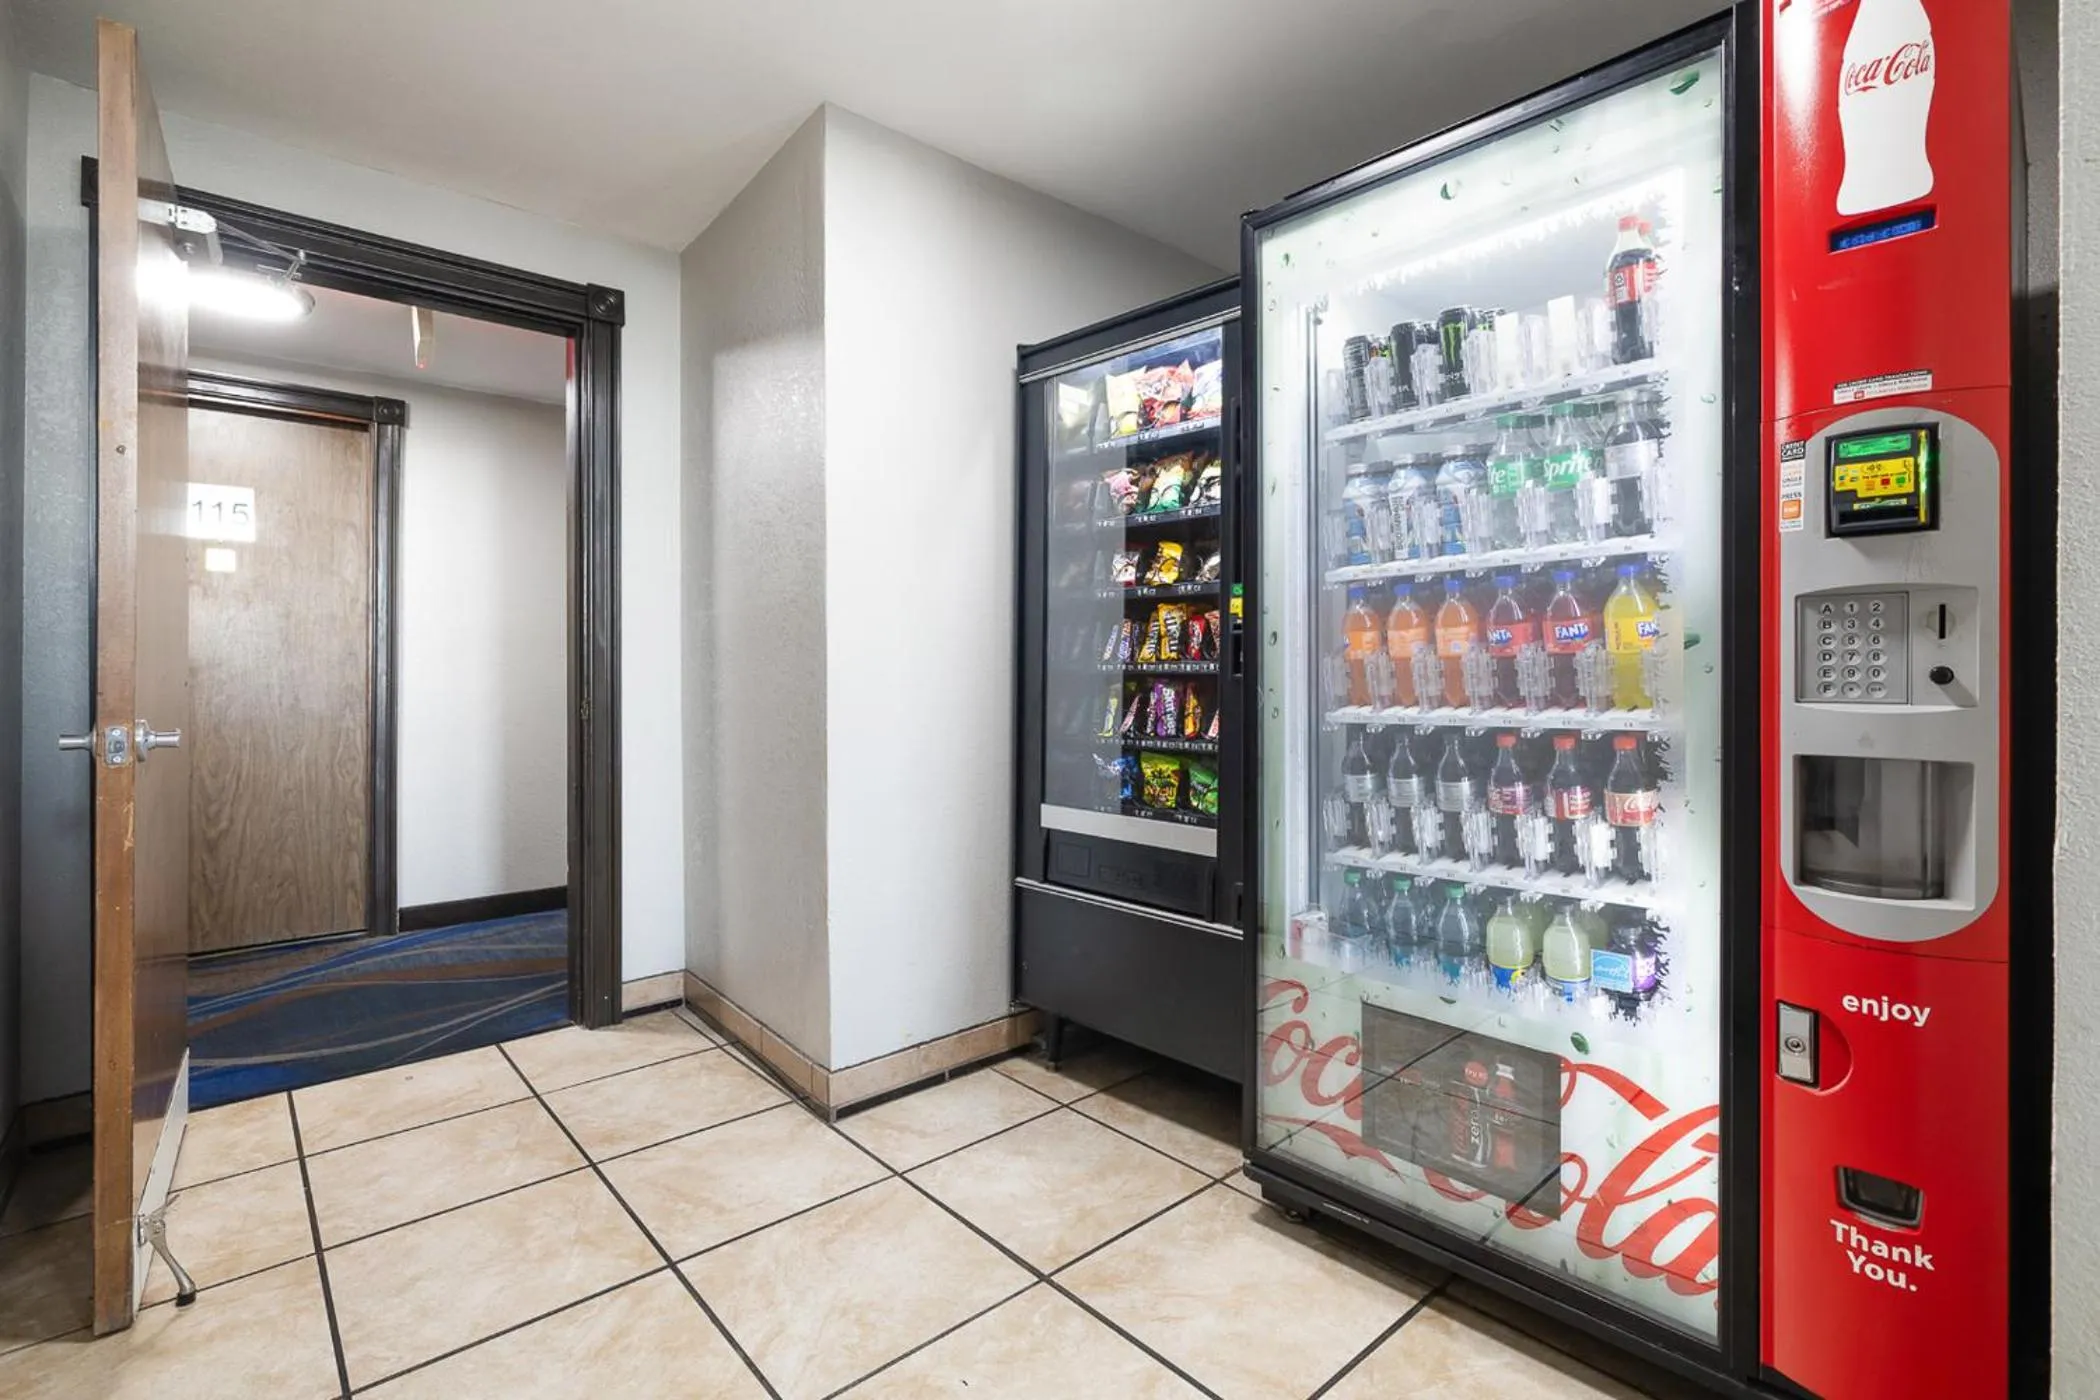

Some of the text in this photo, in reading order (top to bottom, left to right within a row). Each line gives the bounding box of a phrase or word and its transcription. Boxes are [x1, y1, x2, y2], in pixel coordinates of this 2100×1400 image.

[1845, 39, 1931, 96] Coca-Cola
[1782, 447, 1804, 457] CARD
[1544, 453, 1592, 480] Sprite
[192, 500, 248, 526] 115
[1822, 603, 1881, 614] A 1 2
[1555, 622, 1588, 641] FANTA
[1822, 619, 1880, 629] B 3 4
[1822, 636, 1881, 646] C 5 6
[1822, 652, 1880, 662] D 7 8
[1822, 669, 1881, 678] E 9 0
[1822, 684, 1832, 693] F
[1841, 994, 1931, 1027] enjoy
[1471, 1108, 1481, 1144] zero
[1829, 1219, 1935, 1271] Thank
[1847, 1251, 1918, 1292] You.
